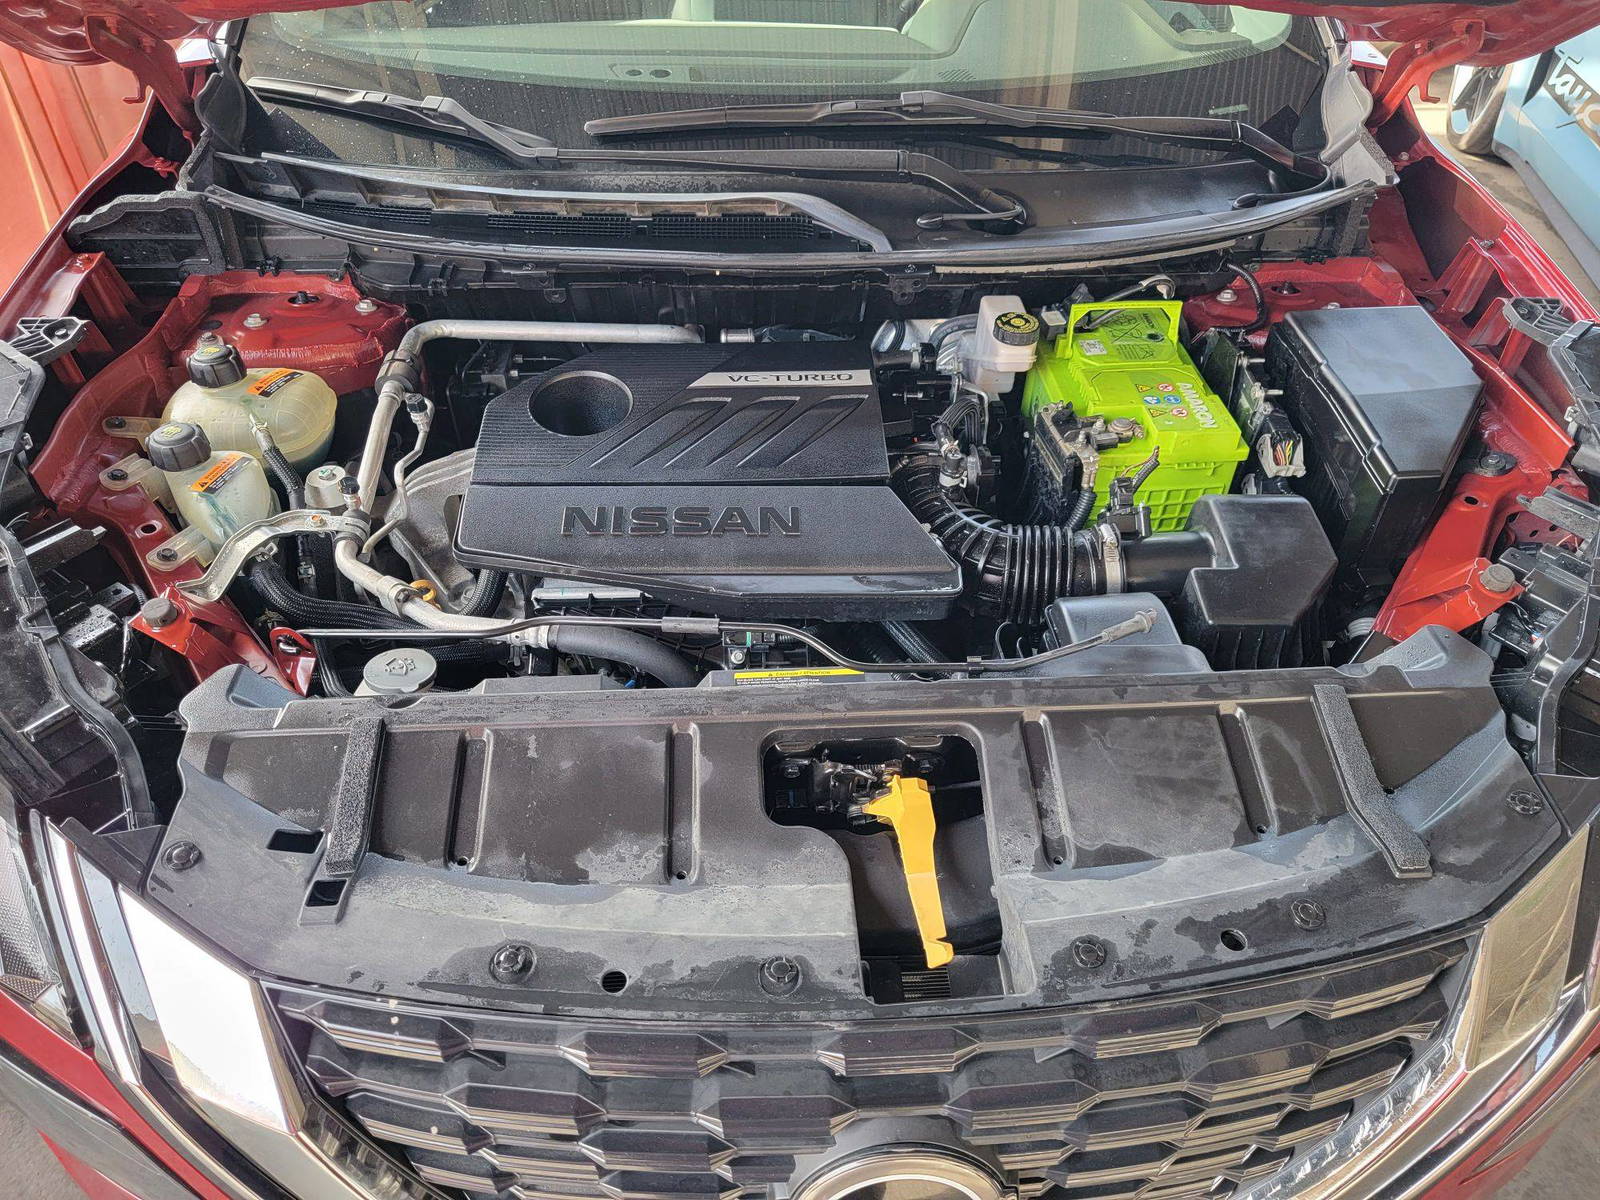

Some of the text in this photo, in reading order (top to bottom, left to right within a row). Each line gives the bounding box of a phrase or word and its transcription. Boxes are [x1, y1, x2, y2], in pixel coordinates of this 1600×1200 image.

[728, 373, 853, 383] VC-TURBO
[1176, 382, 1218, 428] AMARON
[561, 506, 801, 536] NISSAN
